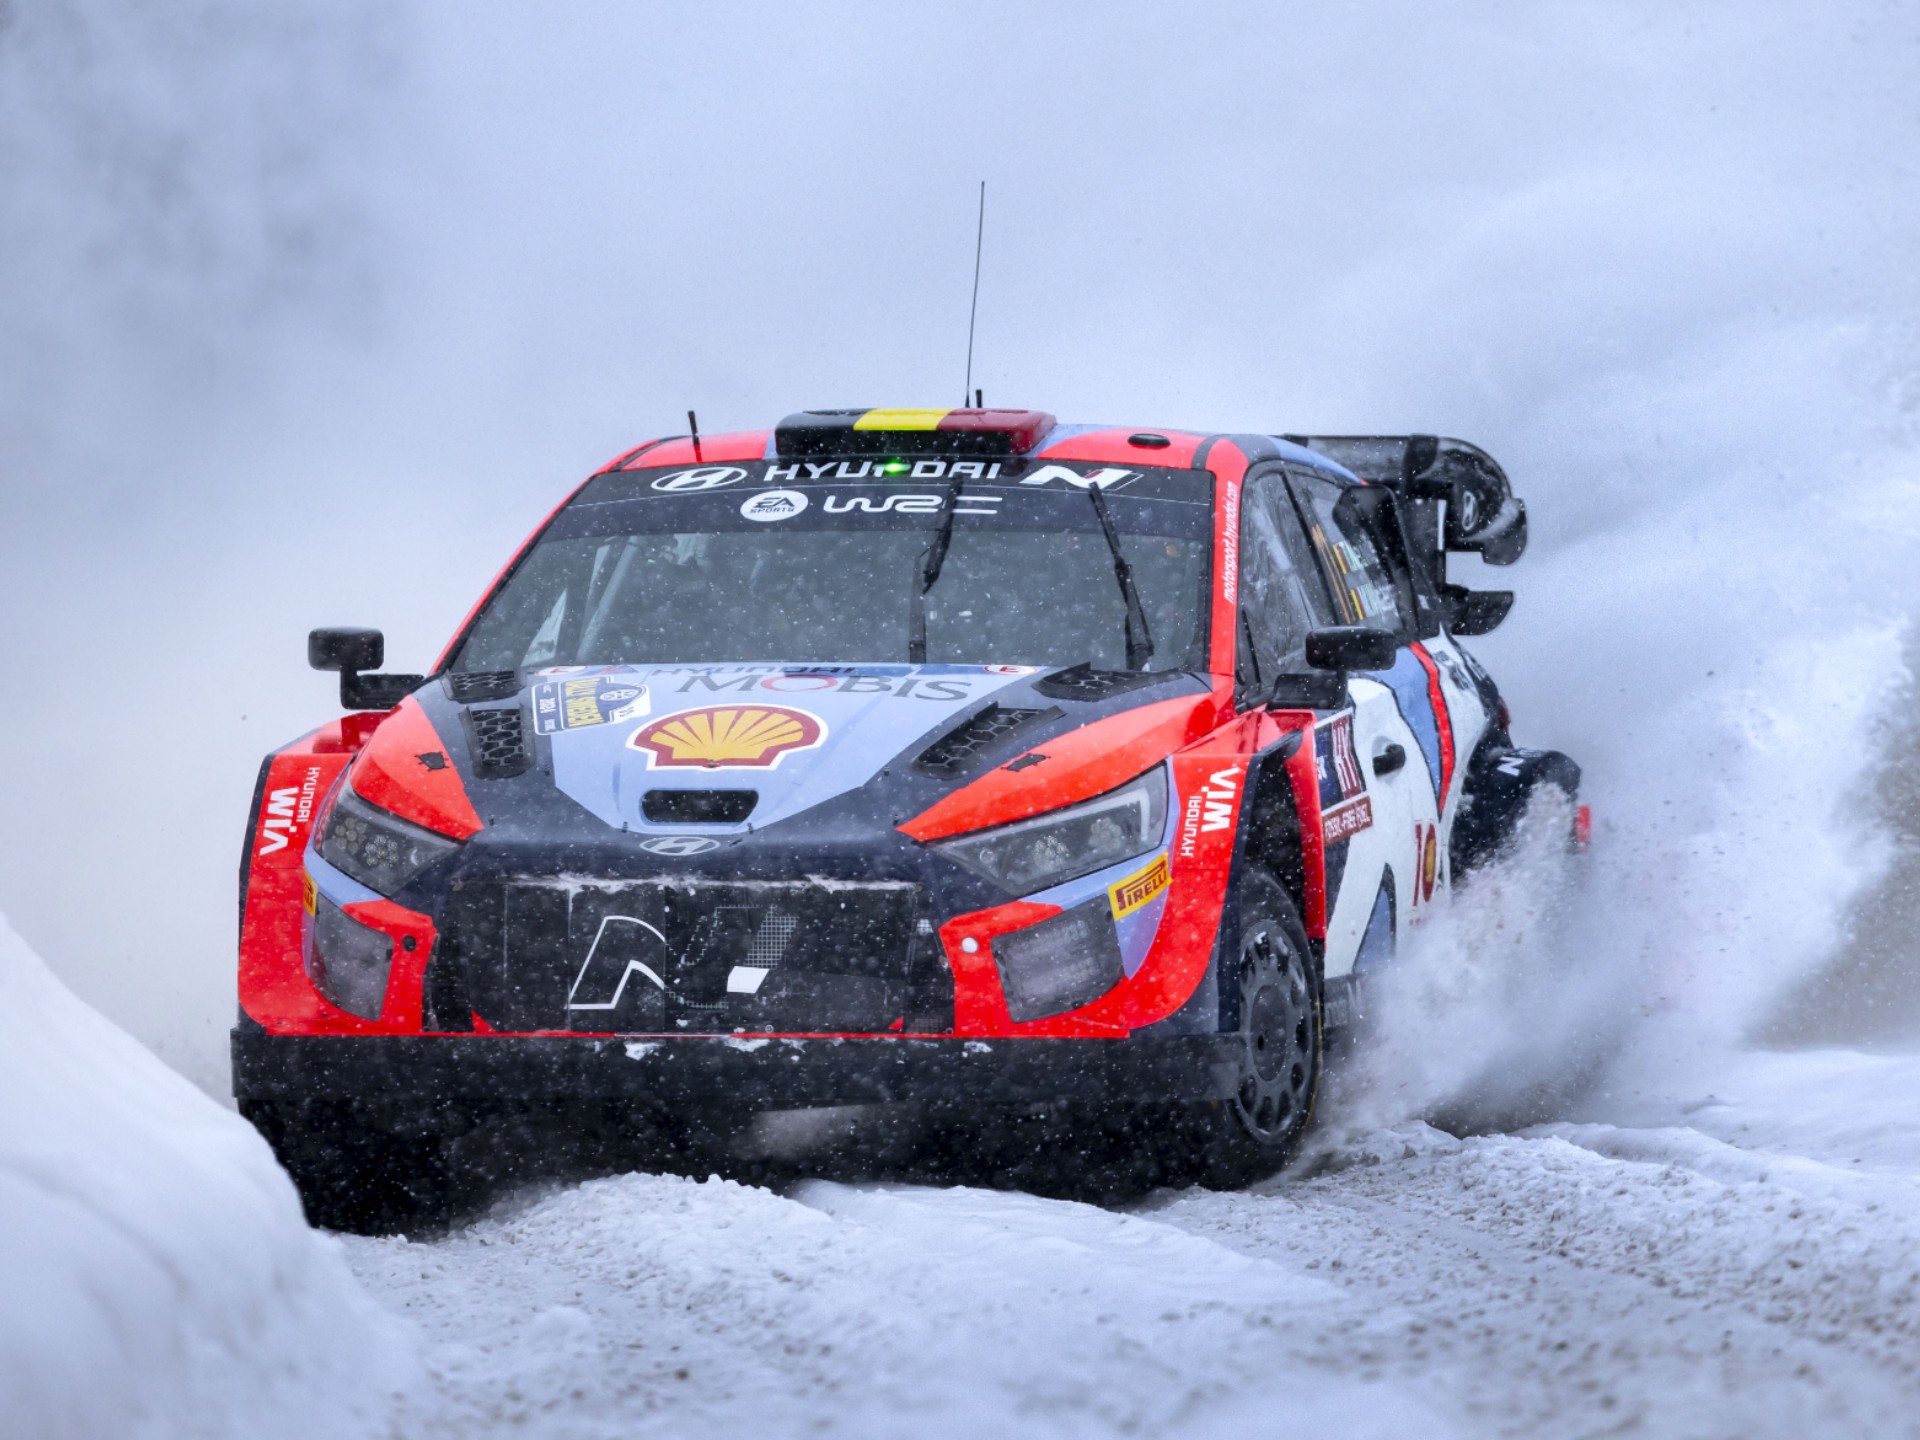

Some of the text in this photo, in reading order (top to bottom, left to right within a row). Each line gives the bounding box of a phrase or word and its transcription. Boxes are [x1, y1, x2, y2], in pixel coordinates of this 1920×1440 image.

[750, 506, 795, 514] SPORTS
[753, 497, 795, 508] EA
[1223, 481, 1238, 604] motorsport.hyundai.com
[650, 665, 857, 677] HYUNDAI
[674, 674, 971, 701] MOBIS
[296, 767, 320, 822] HYUNDAI
[1181, 796, 1202, 857] HYUNDAI
[1115, 860, 1167, 911] PIRELLI
